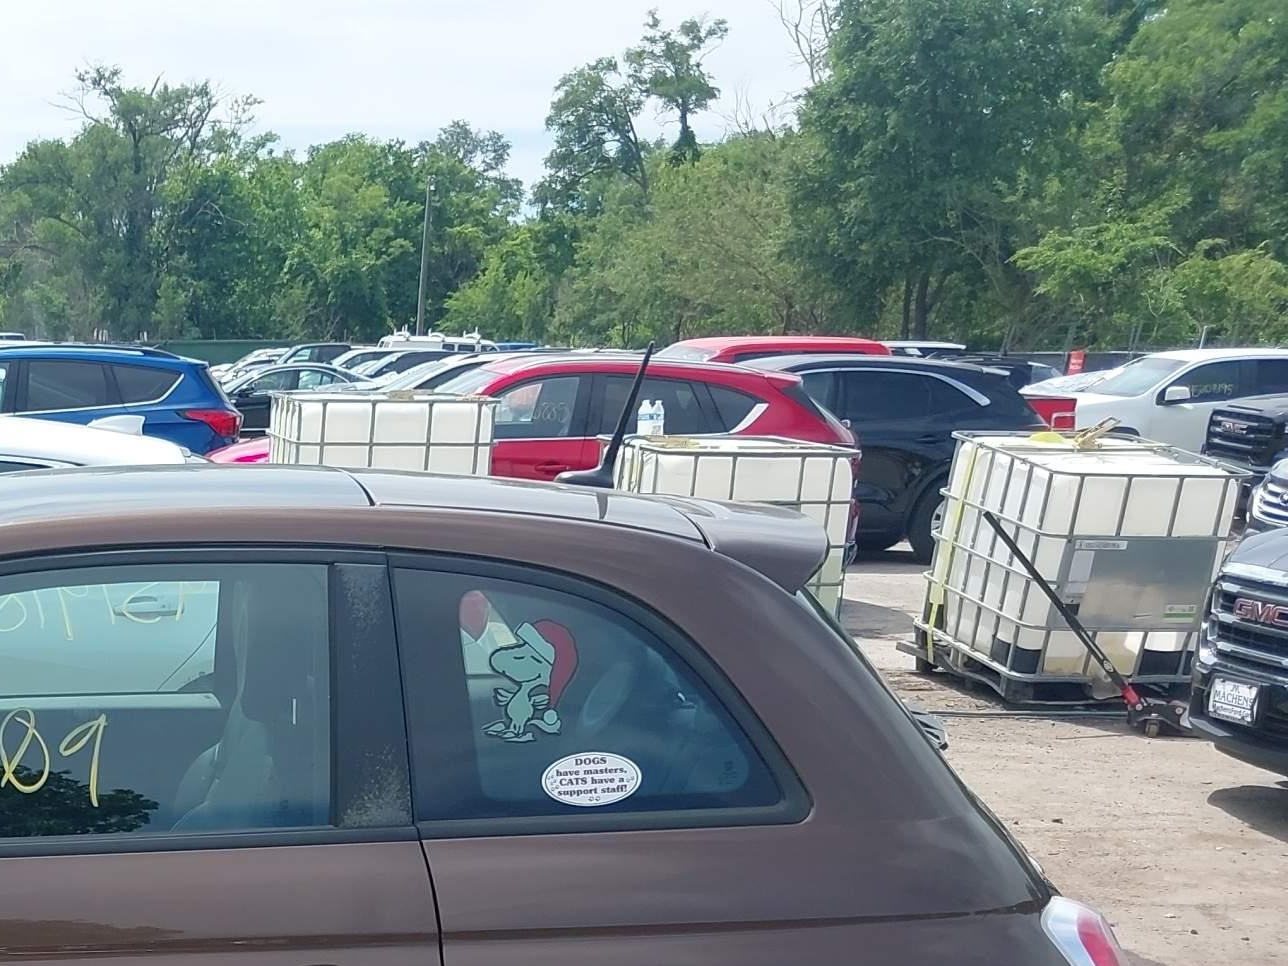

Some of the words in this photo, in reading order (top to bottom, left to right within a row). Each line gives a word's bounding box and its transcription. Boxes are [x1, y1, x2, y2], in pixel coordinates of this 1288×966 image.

[1233, 598, 1288, 627] GMC
[1214, 689, 1255, 708] MACHENS
[575, 757, 607, 766] DOGS
[556, 769, 580, 777] have
[583, 767, 628, 775] masters.
[559, 777, 588, 786] CATS
[591, 776, 615, 785] have
[557, 787, 598, 797] support
[601, 784, 628, 794] staff!
